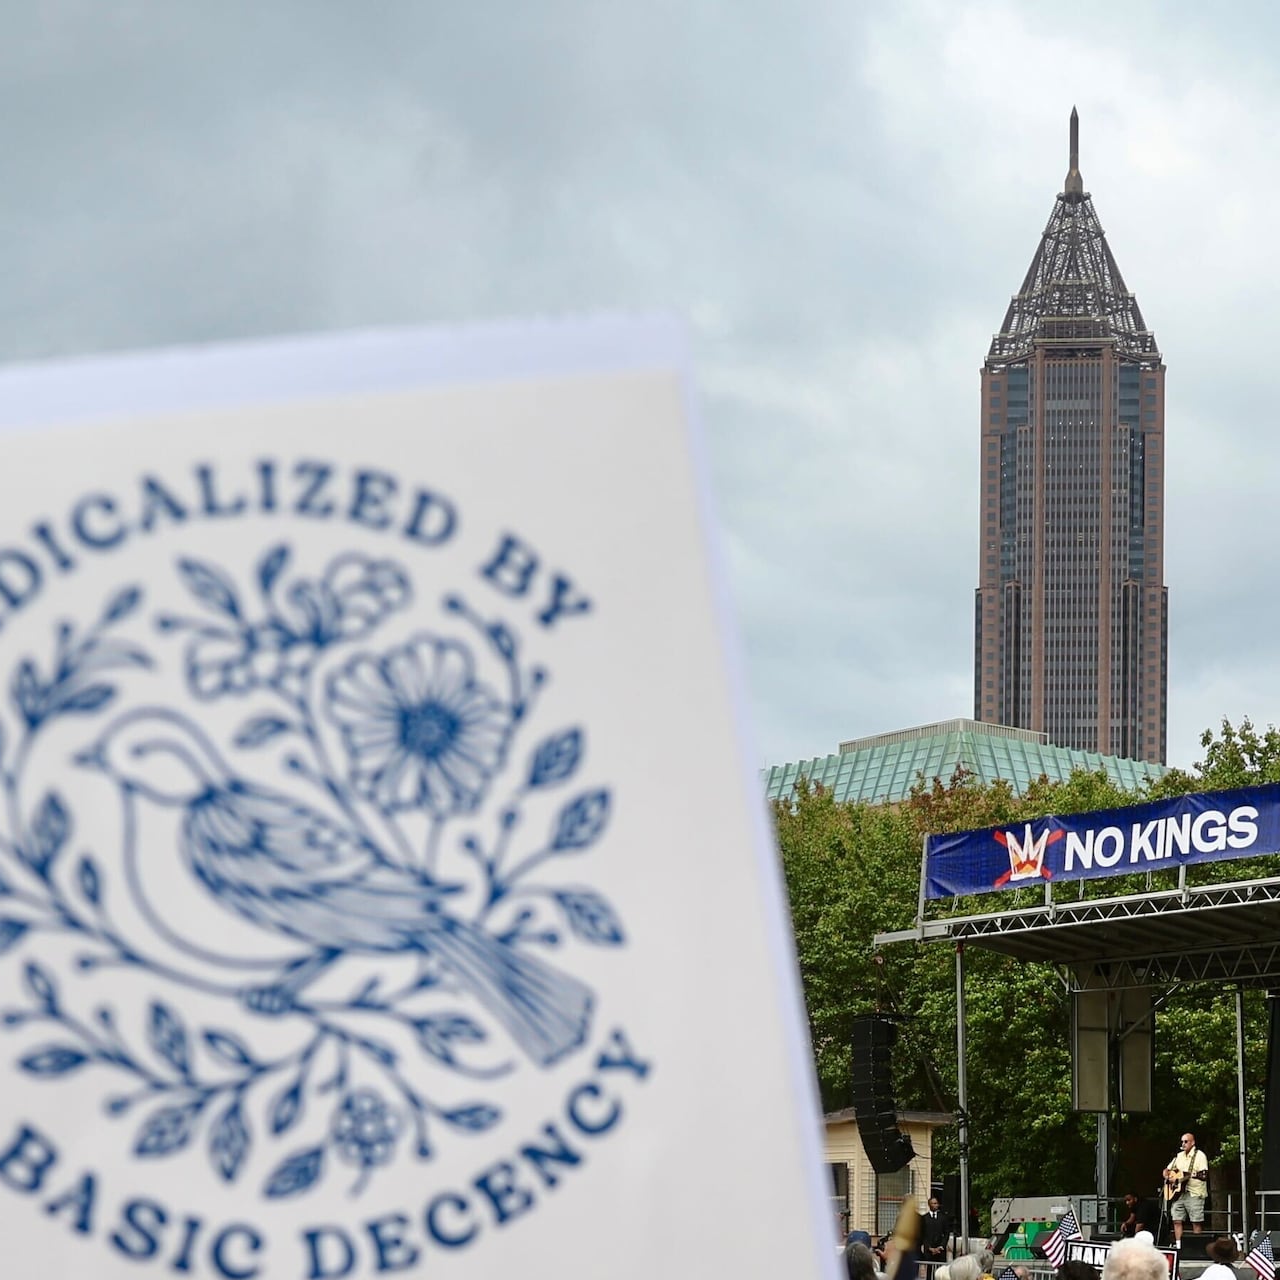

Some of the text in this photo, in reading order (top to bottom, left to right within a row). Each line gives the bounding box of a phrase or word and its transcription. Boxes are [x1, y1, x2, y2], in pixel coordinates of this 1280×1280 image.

[477, 531, 596, 629] BY
[1064, 806, 1259, 871] NO KINGS
[1071, 1246, 1108, 1266] HAN
